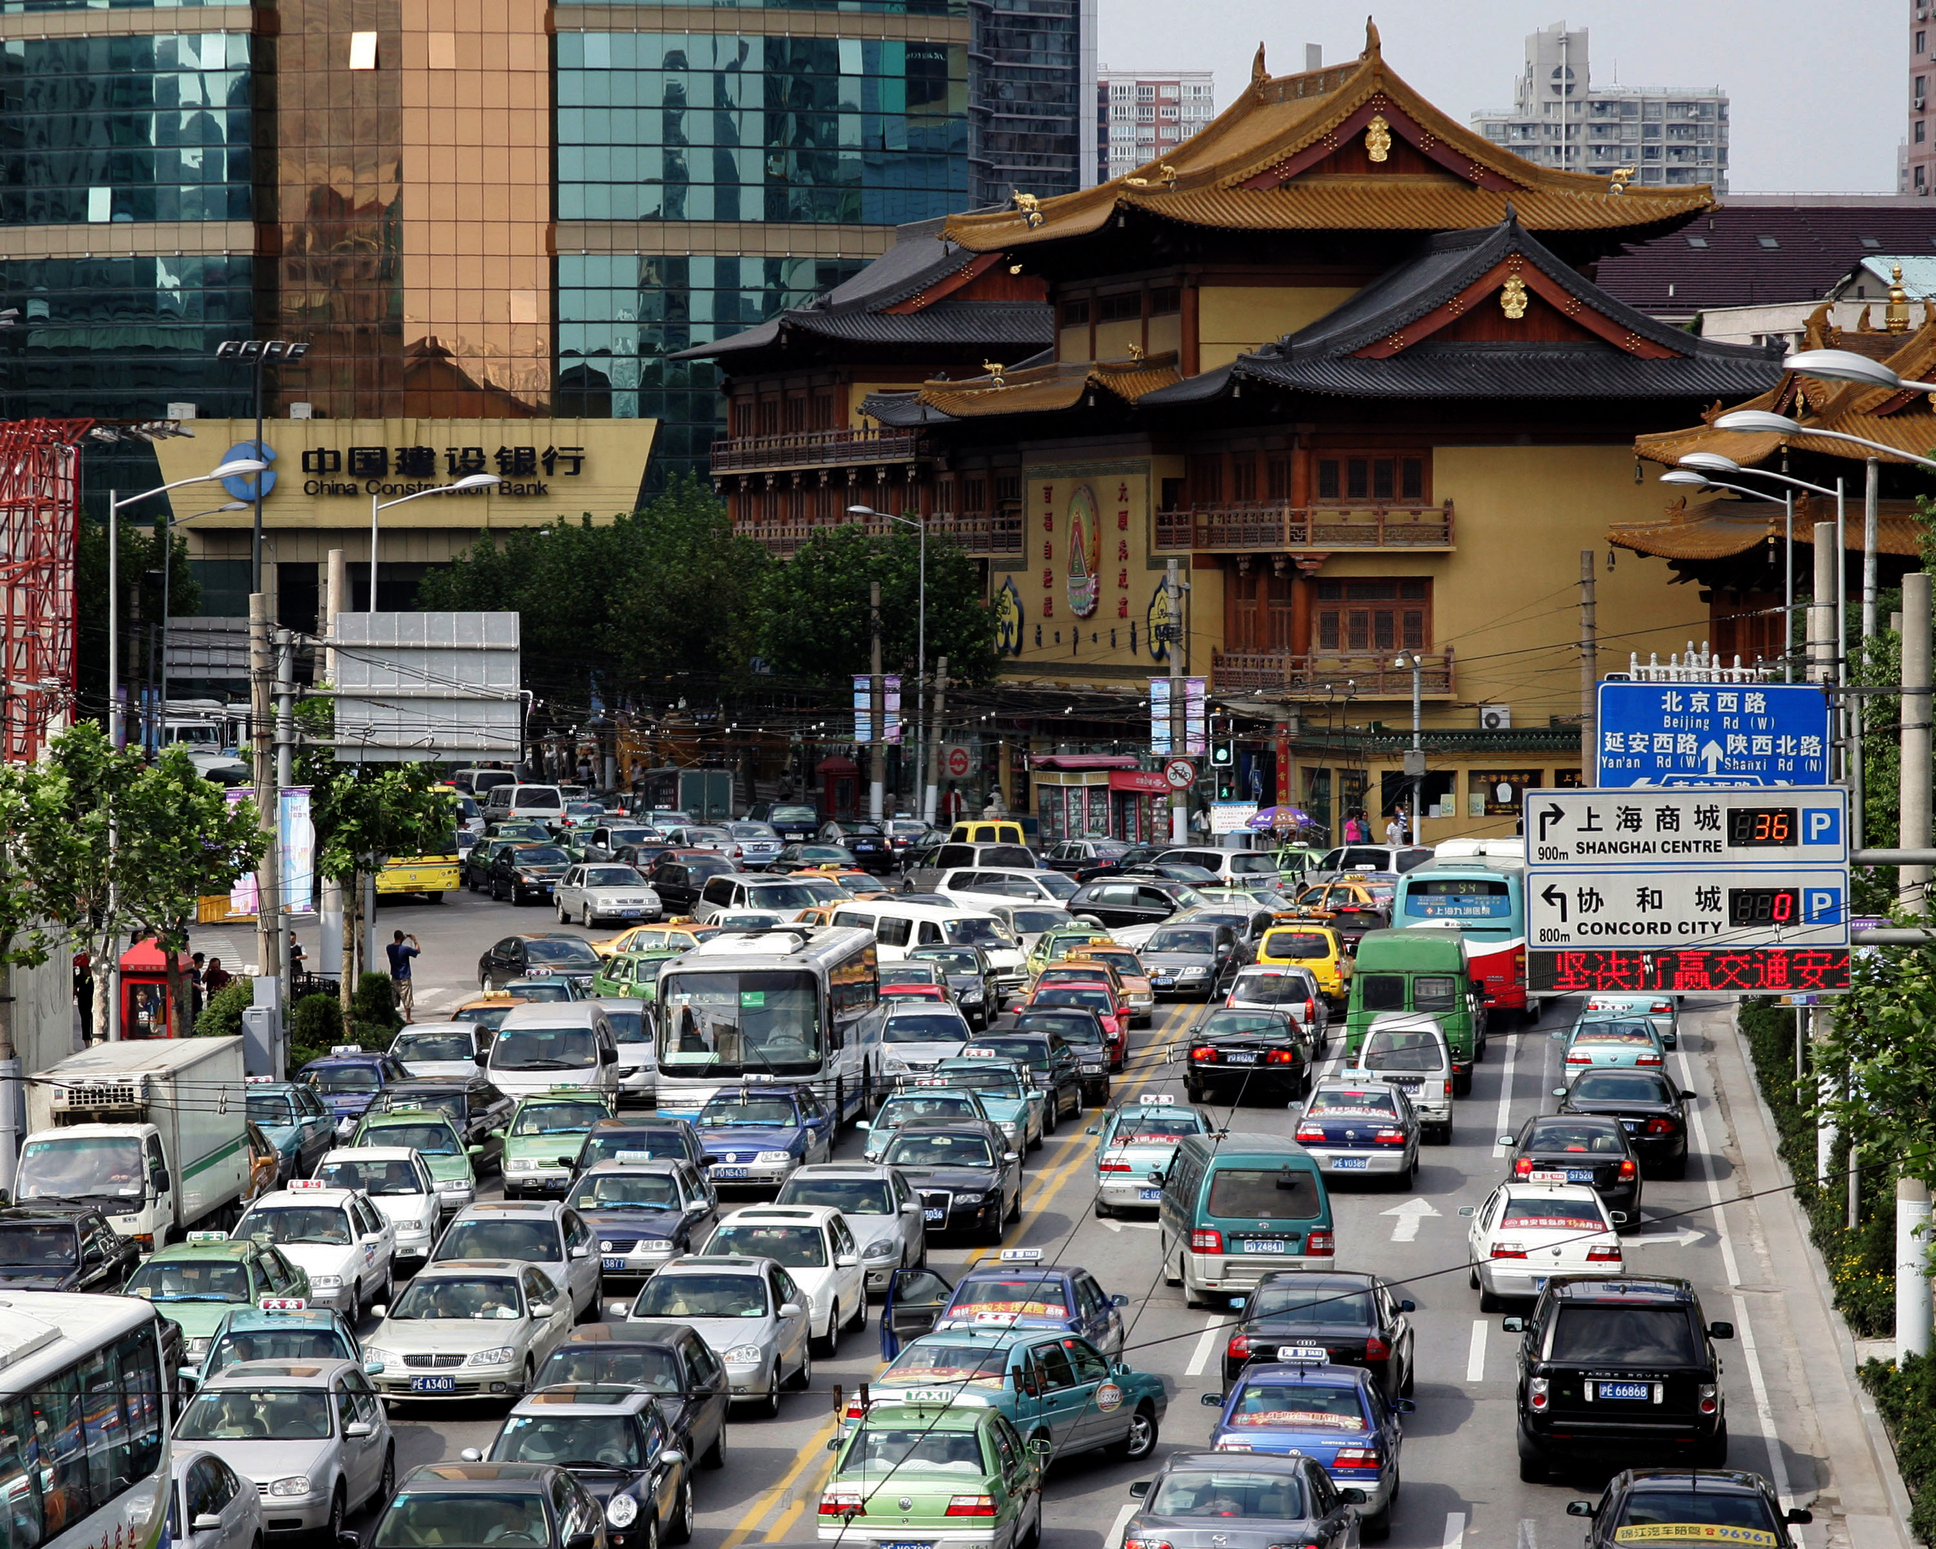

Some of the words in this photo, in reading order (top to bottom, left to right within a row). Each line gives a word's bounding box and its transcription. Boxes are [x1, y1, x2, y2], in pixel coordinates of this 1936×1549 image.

[302, 445, 586, 477] 中国建设银行
[303, 479, 358, 496] China
[499, 480, 549, 496] Bank
[1661, 690, 1767, 714] 北京西路
[1663, 716, 1710, 730] Beijing
[1723, 716, 1739, 729] Rd
[1749, 716, 1776, 731] (W)
[1604, 732, 1699, 755] 延安西路
[1726, 734, 1823, 757] 陕西北路
[1601, 754, 1641, 769] Yan'an
[1656, 755, 1672, 769] Rd
[1679, 755, 1702, 770] (W)
[1724, 756, 1767, 772] Shanxi
[1778, 758, 1794, 772] Rd
[1805, 759, 1823, 773] (N)
[1576, 804, 1722, 833] 上海商城
[1755, 813, 1789, 841] 36
[1810, 813, 1832, 841] P
[1537, 846, 1569, 861] 900m
[1576, 841, 1657, 855] SHANGHAI
[1660, 840, 1723, 853] CENTRE
[1576, 885, 1723, 914] 协和城
[1812, 892, 1833, 920] P
[1539, 928, 1571, 943] 800m
[1576, 921, 1672, 936] CONCORD
[1677, 921, 1723, 936] CITY
[1257, 1242, 1282, 1251] 24841
[267, 1300, 299, 1309] 大众
[425, 1379, 453, 1390] A3401
[1615, 1386, 1648, 1398] 66868
[910, 1391, 950, 1401] TAXI
[1718, 1528, 1772, 1545] 96961
